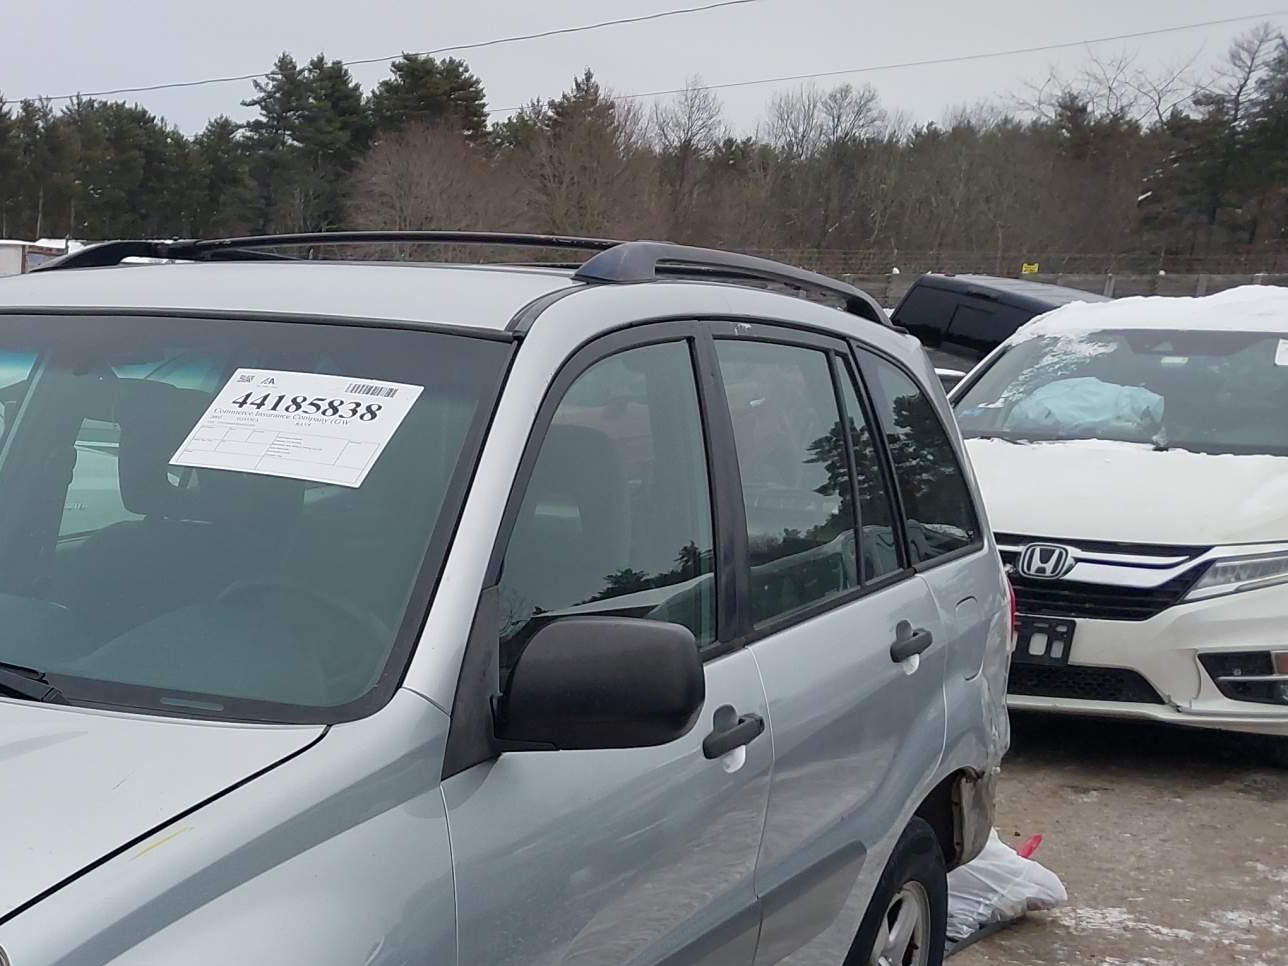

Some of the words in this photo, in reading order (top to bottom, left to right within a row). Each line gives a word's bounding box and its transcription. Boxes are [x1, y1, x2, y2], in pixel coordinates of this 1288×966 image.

[213, 407, 253, 416] Commerce
[255, 411, 291, 419] Insurance
[293, 414, 328, 425] Company
[232, 391, 382, 422] 44185838
